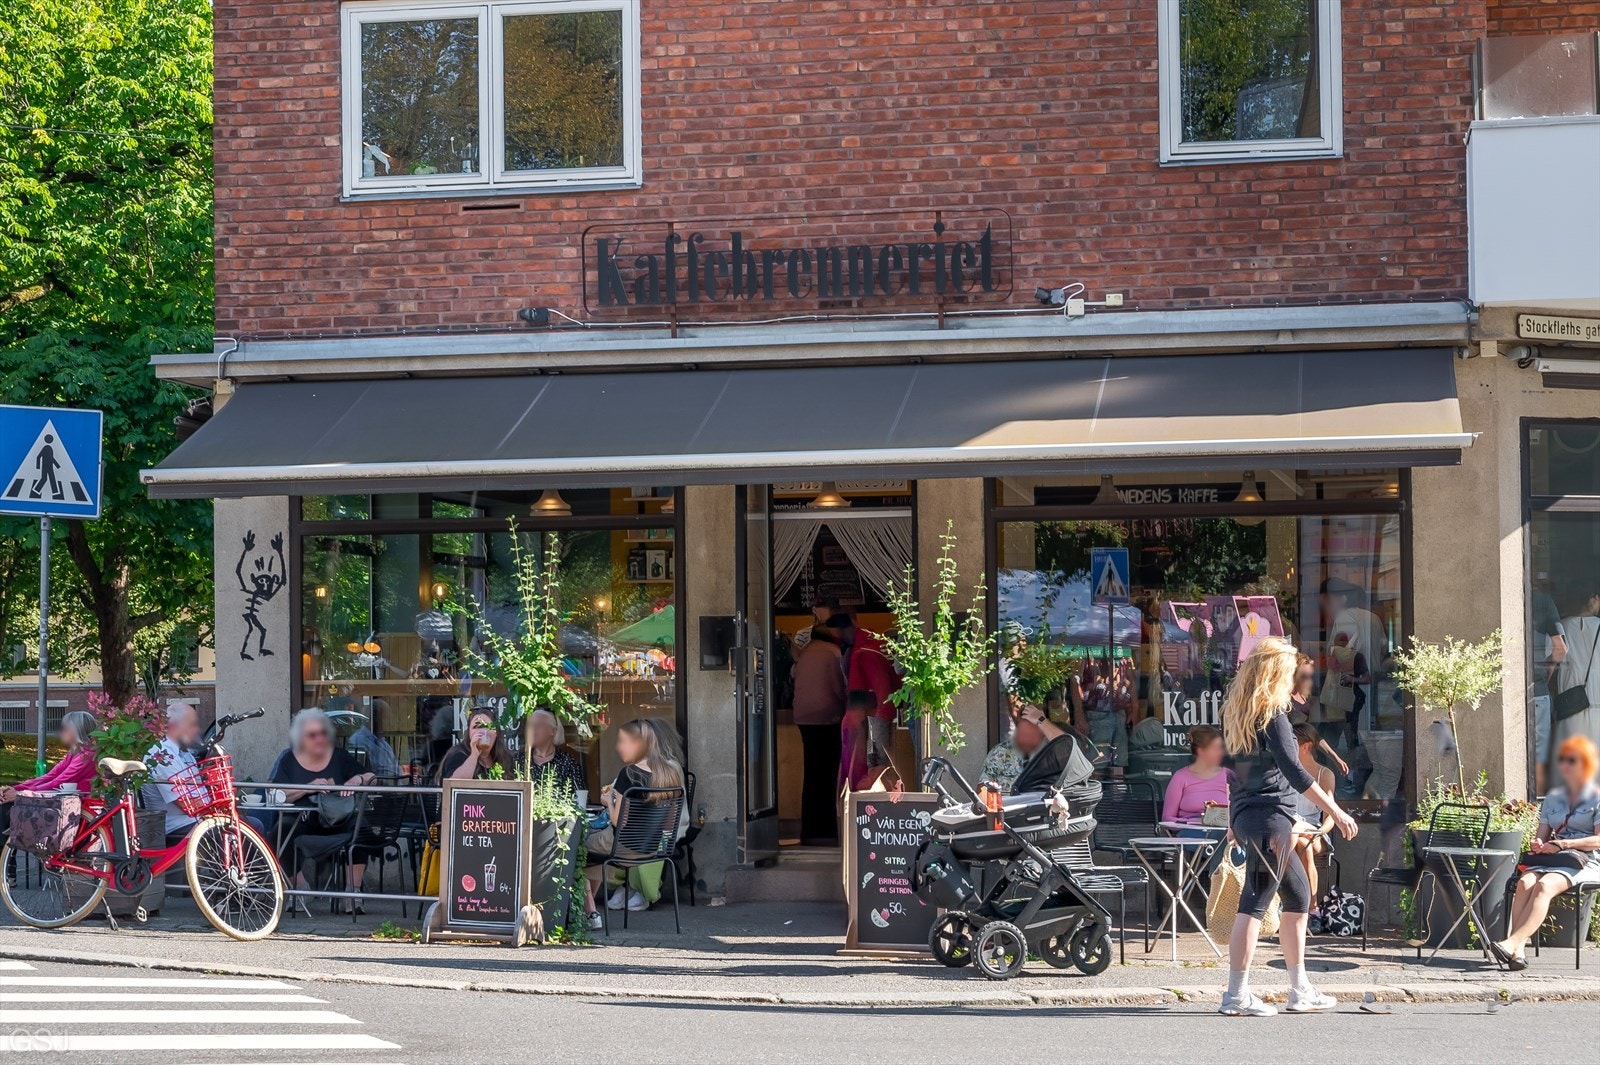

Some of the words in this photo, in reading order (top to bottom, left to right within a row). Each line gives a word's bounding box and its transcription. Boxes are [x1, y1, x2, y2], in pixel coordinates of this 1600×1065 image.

[595, 221, 1000, 307] Kaffebrenneriet
[1526, 319, 1581, 335] Stockfleths
[1178, 488, 1218, 503] KAFFE
[463, 804, 485, 818] PINK
[462, 820, 516, 835] GRAPEFRUIT
[876, 816, 895, 829] VÅR
[899, 819, 922, 830] EGEN
[462, 835, 474, 847] ICE
[478, 835, 493, 848] TEA
[870, 832, 924, 846] LIMONADE
[878, 877, 909, 886] BRINGEB
[889, 887, 913, 895] SITRON
